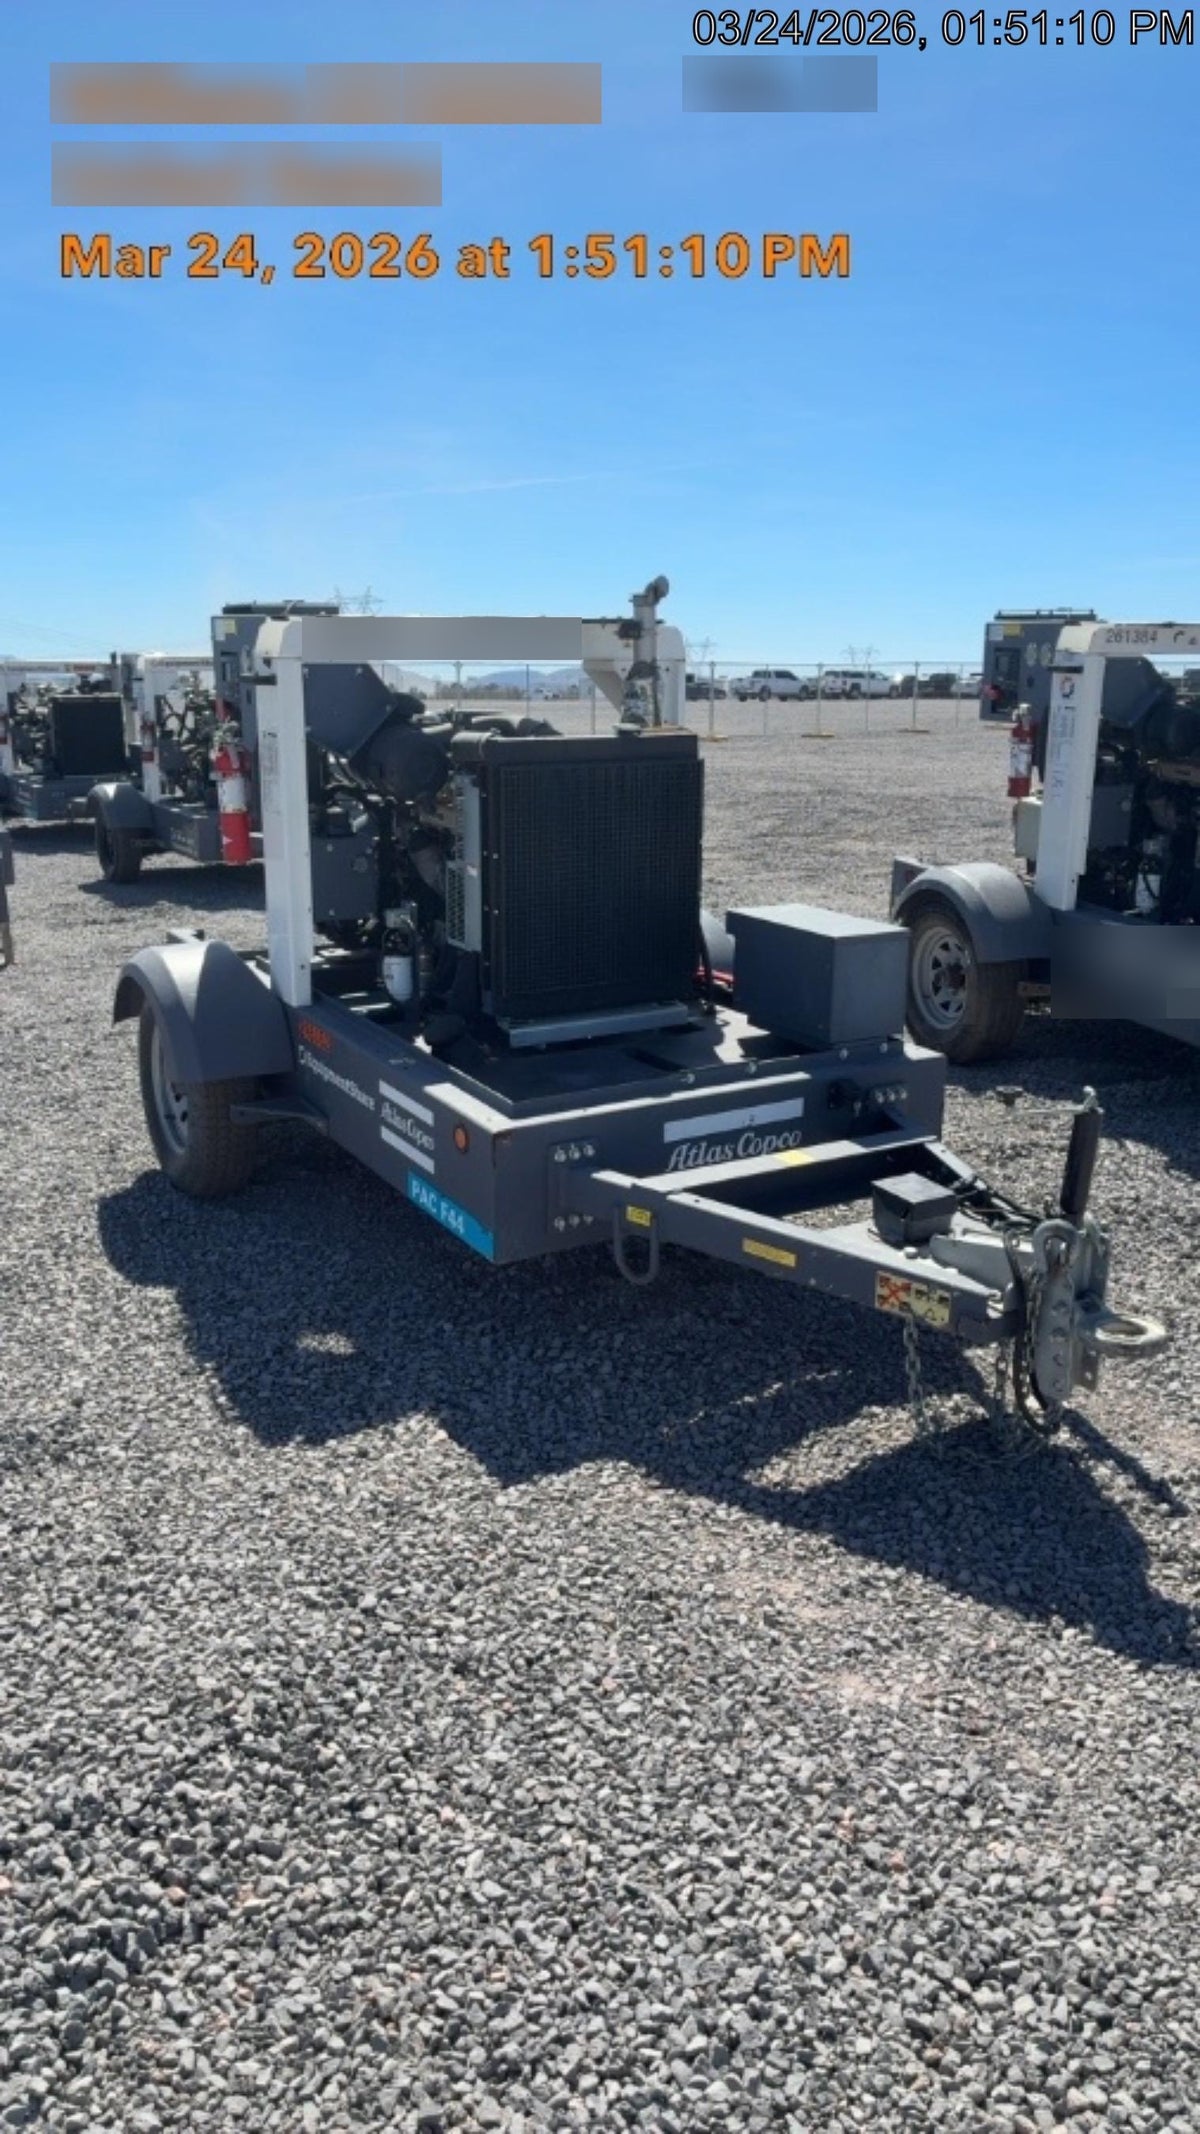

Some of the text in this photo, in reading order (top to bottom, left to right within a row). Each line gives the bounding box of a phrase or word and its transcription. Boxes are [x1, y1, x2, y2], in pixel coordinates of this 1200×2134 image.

[666, 1131, 802, 1171] Atlas Copco
[411, 1179, 465, 1234] PAC F44
